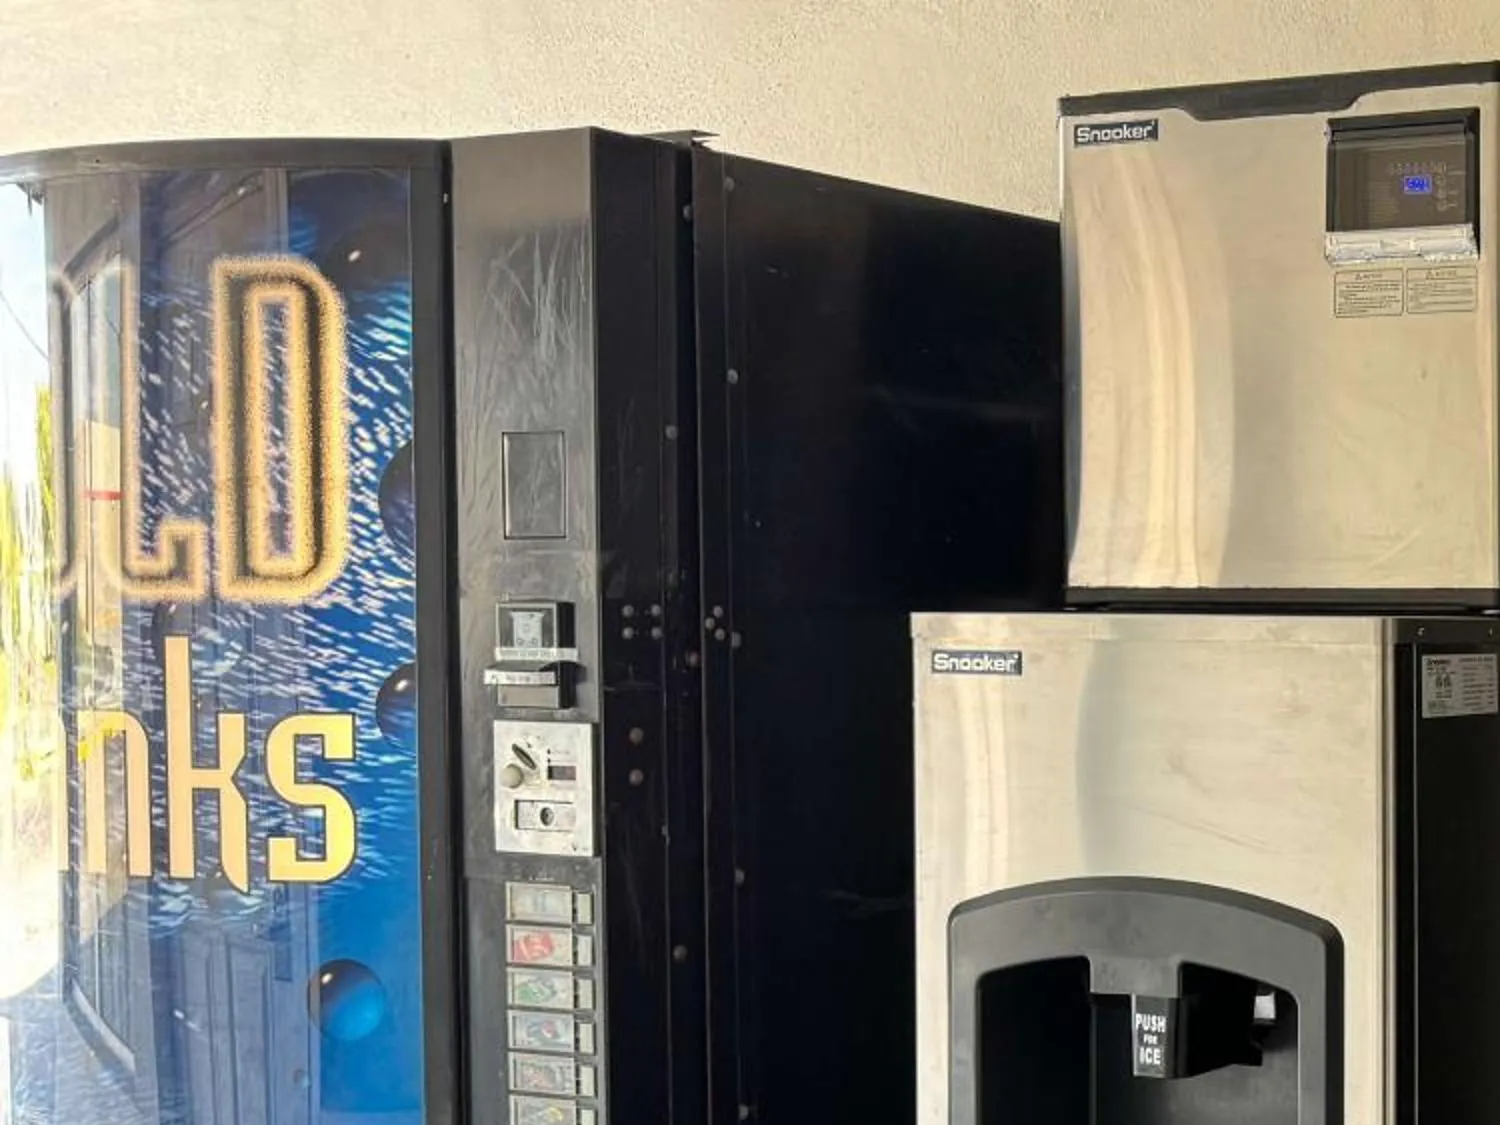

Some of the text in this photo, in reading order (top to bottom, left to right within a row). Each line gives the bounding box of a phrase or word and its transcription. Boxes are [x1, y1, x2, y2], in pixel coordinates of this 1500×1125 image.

[1077, 123, 1153, 143] Snooker
[933, 653, 1016, 672] Snooker
[1135, 1013, 1167, 1033] PUSH
[1143, 1033, 1159, 1045] FOR
[1139, 1047, 1162, 1065] ICE
